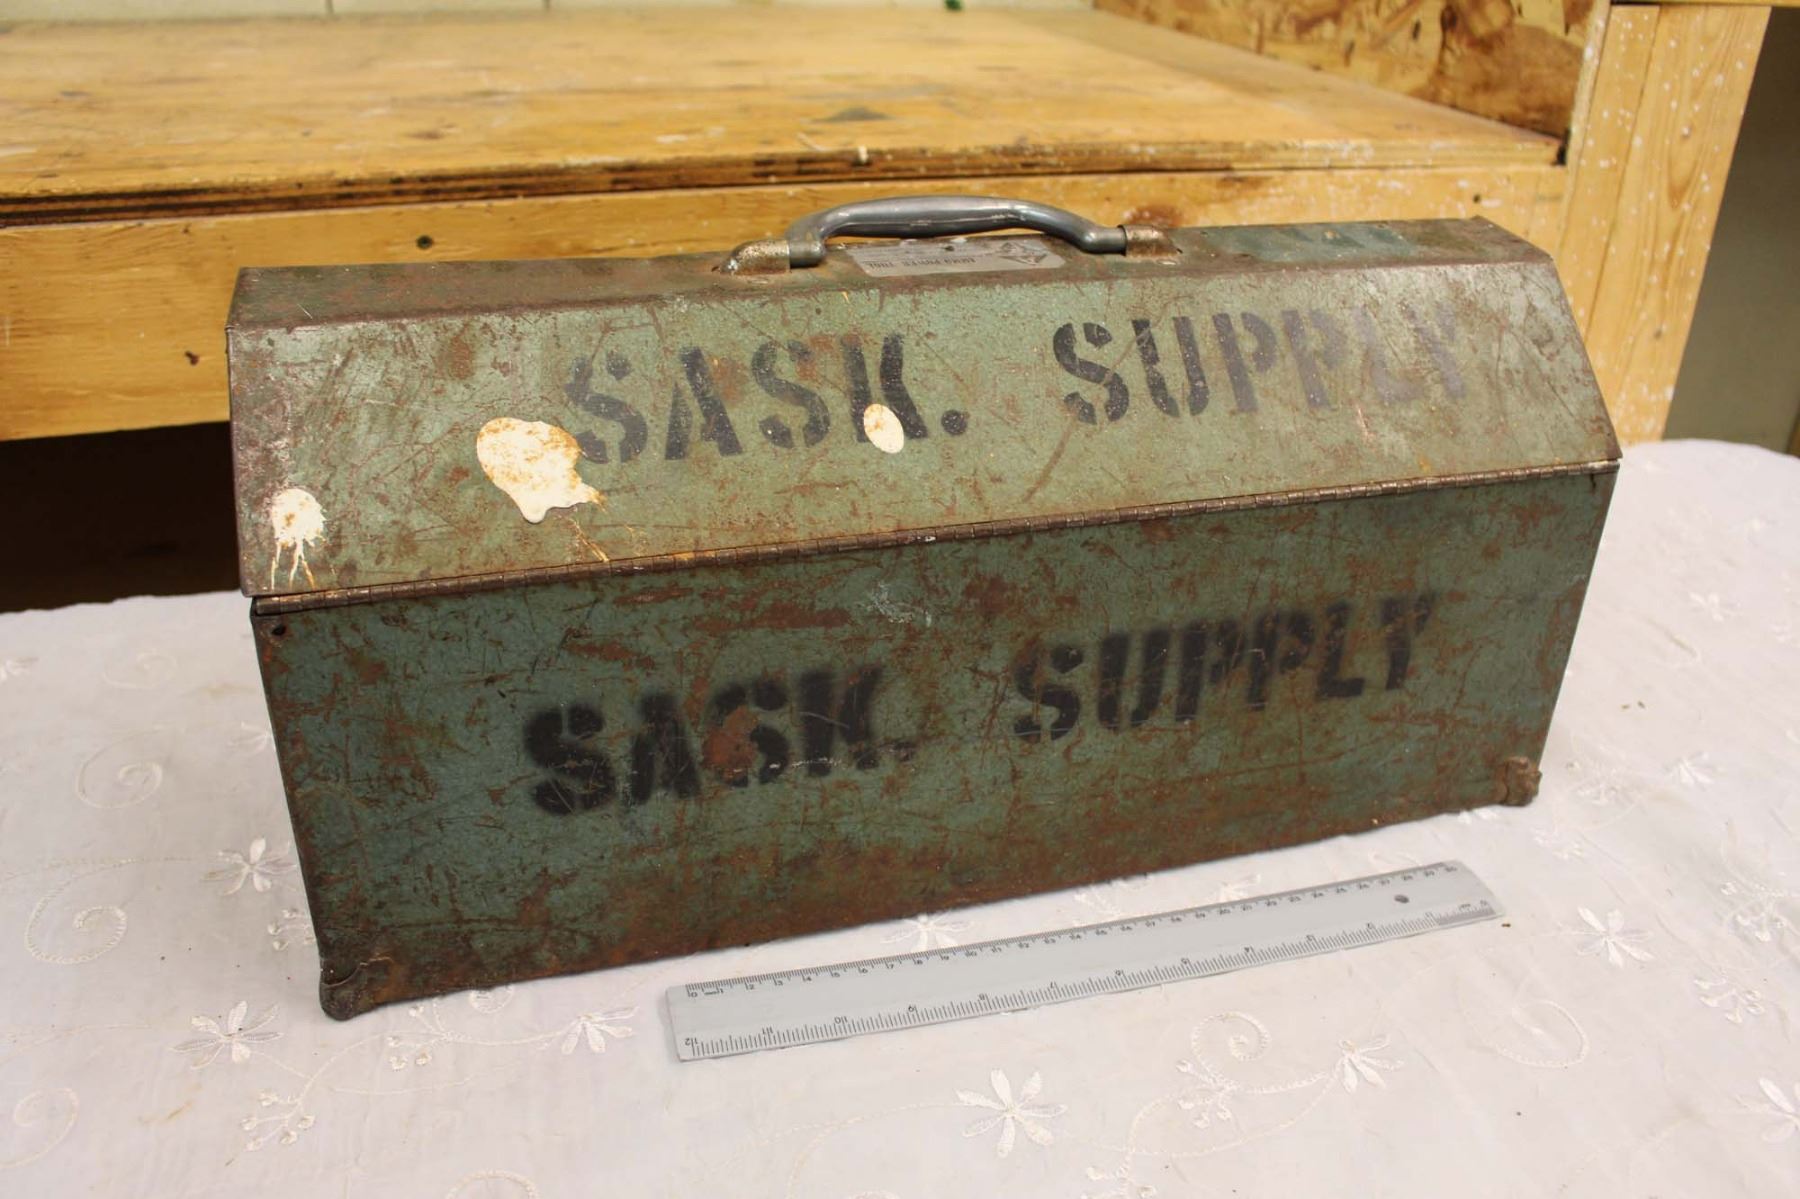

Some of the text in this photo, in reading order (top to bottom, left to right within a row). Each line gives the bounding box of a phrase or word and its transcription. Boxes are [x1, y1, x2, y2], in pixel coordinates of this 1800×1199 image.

[565, 303, 1466, 464] SASK. SUPPLY
[1013, 594, 1434, 742] SUPPLY
